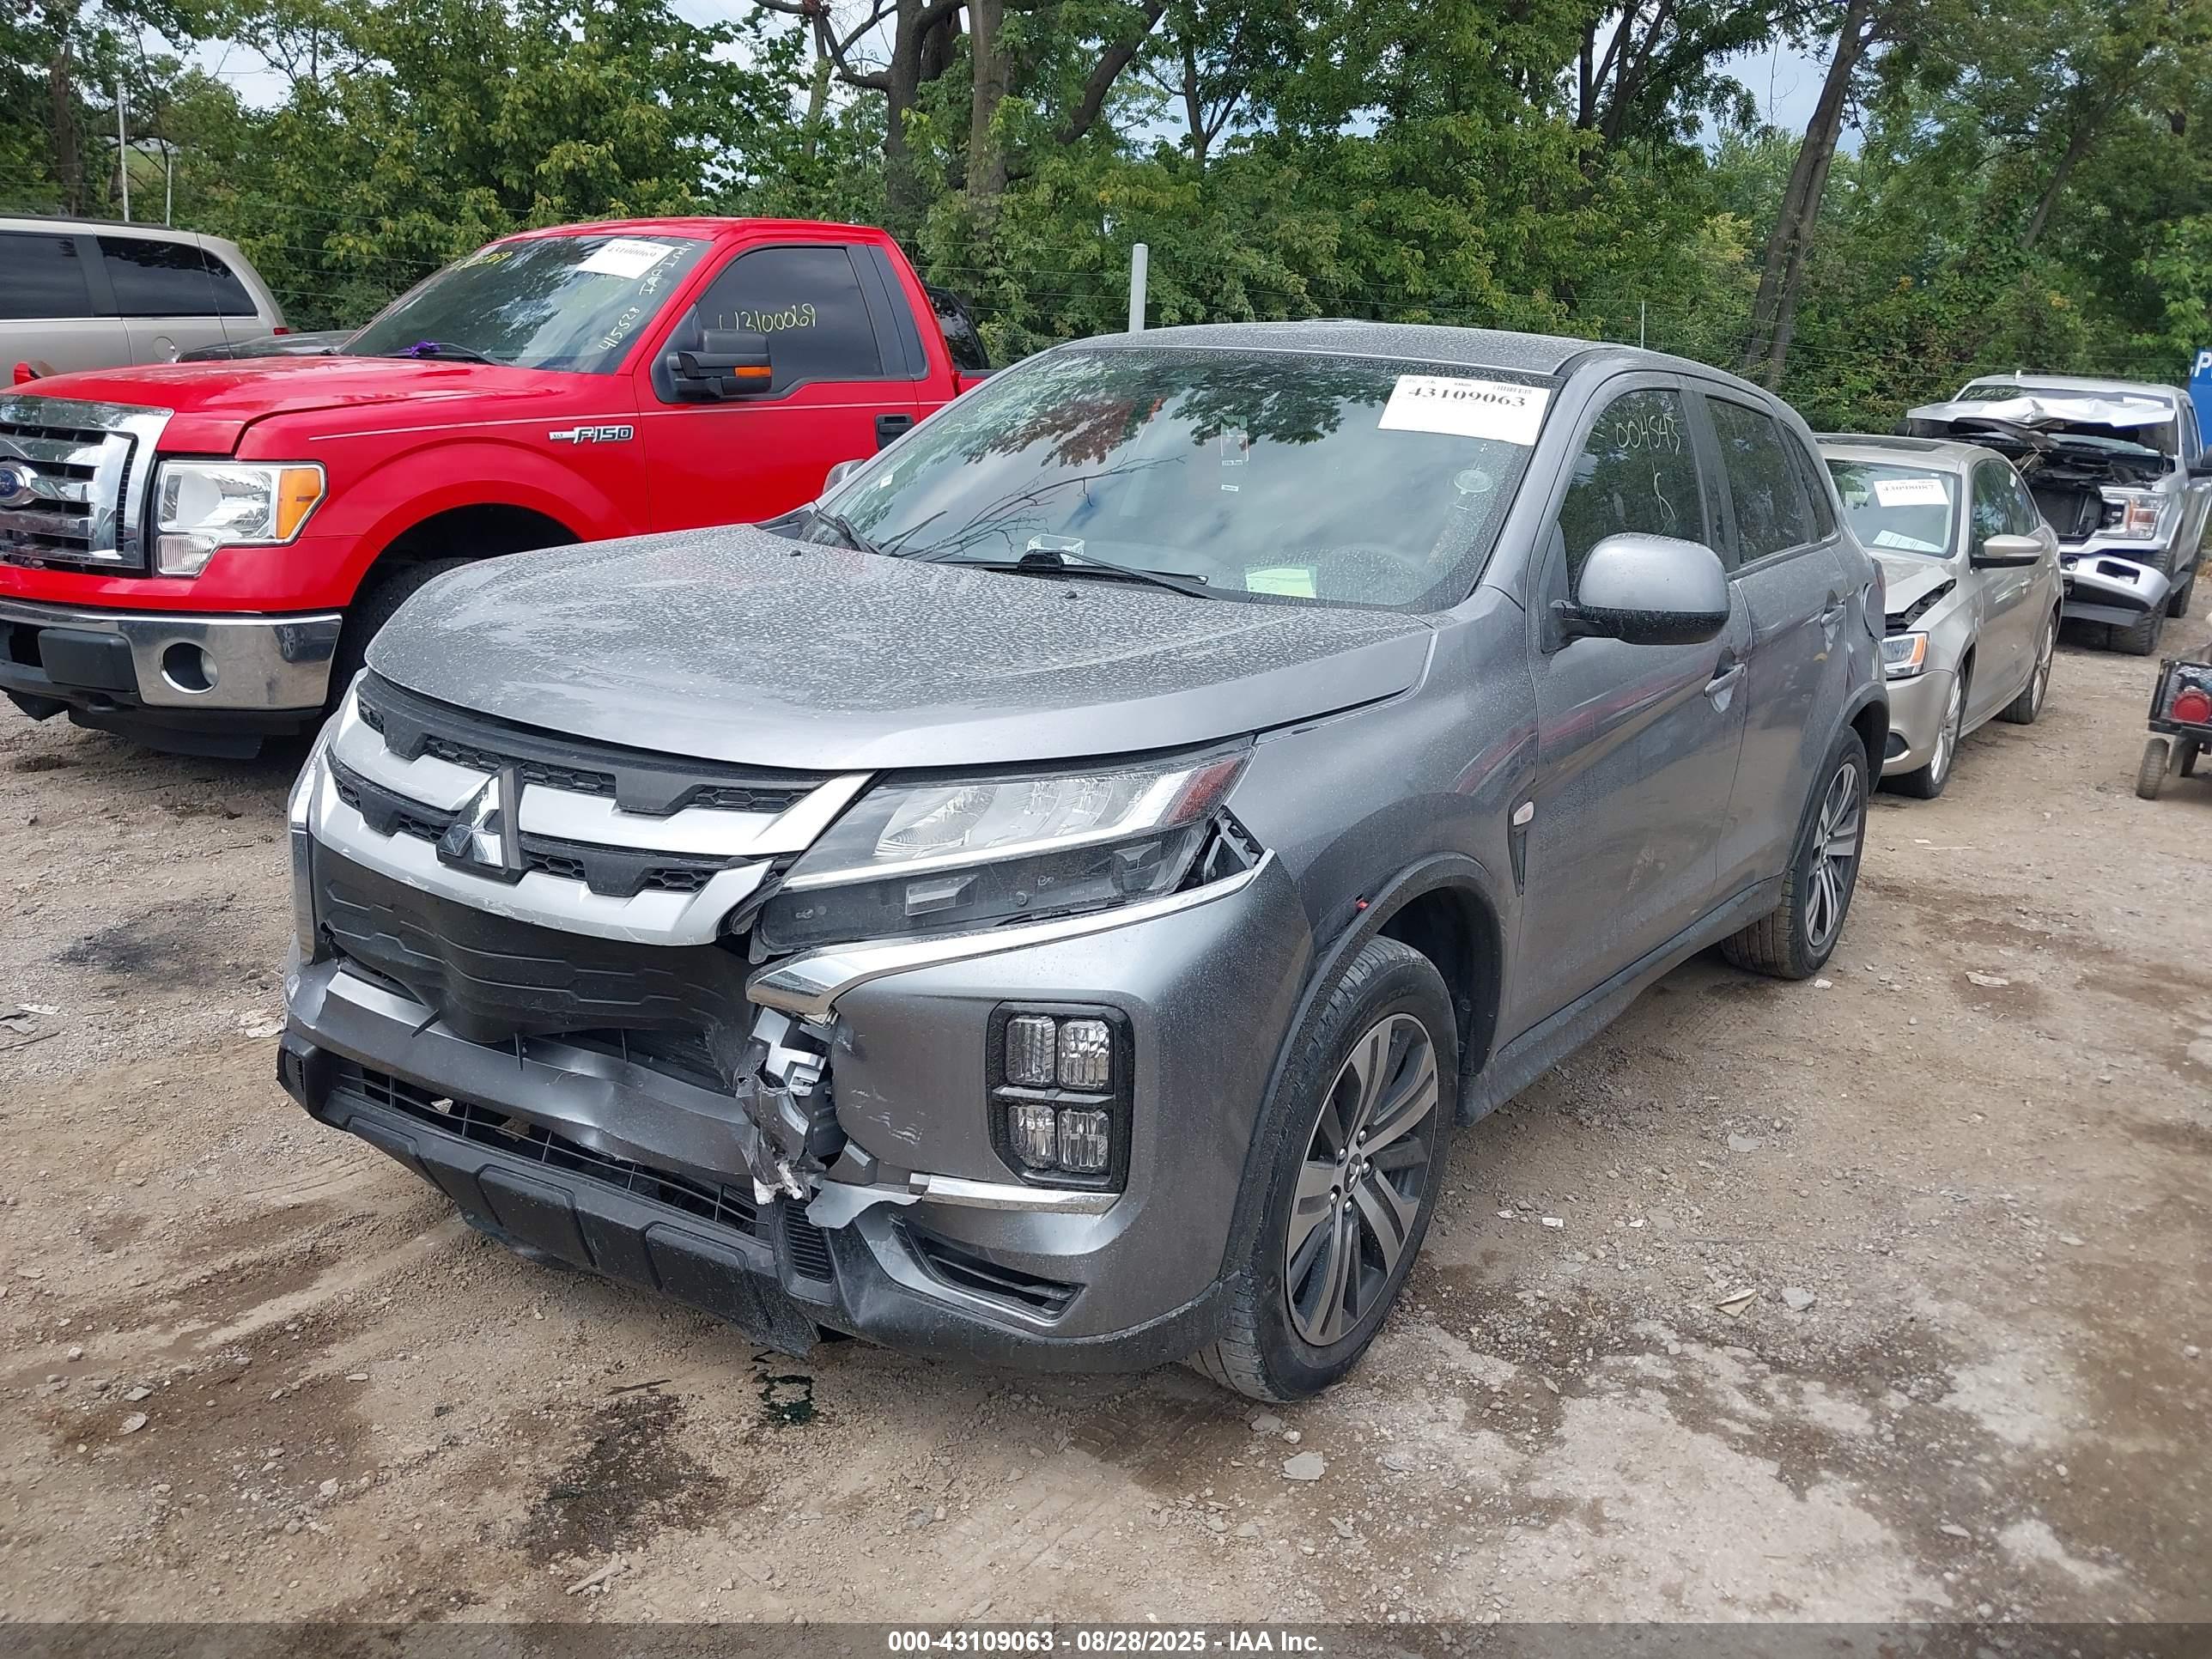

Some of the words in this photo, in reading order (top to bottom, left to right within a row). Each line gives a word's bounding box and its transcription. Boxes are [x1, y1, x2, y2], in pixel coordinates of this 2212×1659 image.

[598, 307, 641, 350] 415528
[1407, 386, 1526, 407] 43109063
[573, 425, 634, 444] F-150
